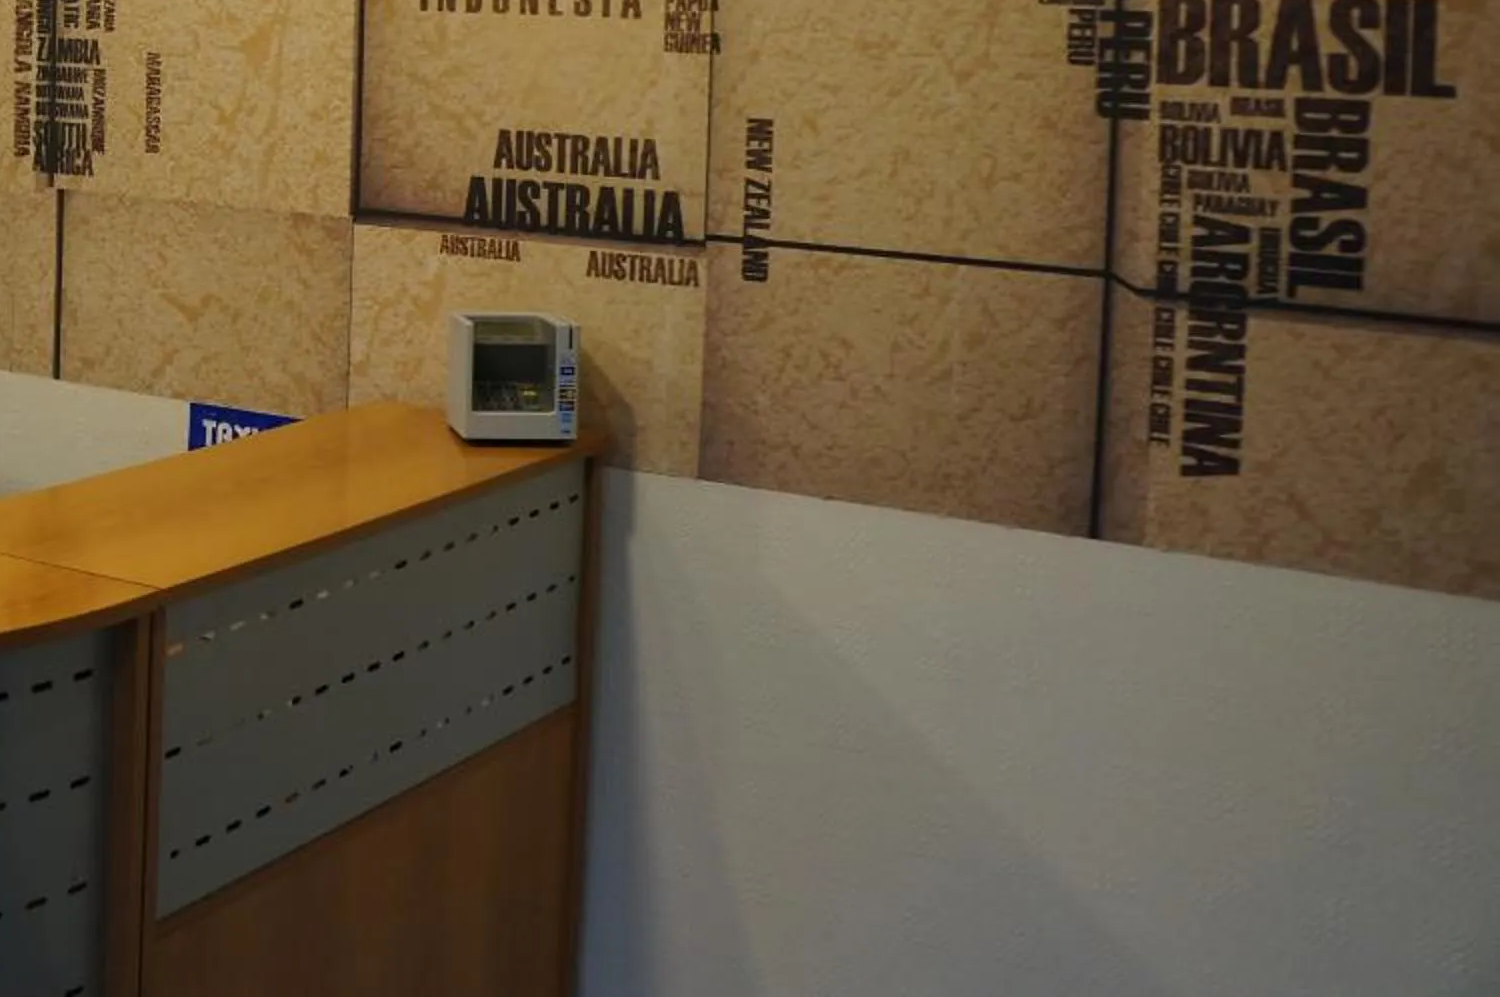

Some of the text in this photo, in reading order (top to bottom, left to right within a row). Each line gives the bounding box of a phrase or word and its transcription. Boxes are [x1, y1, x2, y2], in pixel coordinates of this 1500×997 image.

[662, 32, 722, 55] GUINEA
[663, 12, 703, 33] NEW
[1067, 7, 1097, 67] PERU
[1099, 9, 1151, 120] PERU
[492, 127, 662, 182] AUSTRALIA
[1157, 123, 1290, 173] BOLIVIA
[463, 173, 685, 243] AUSTRALIA
[740, 116, 776, 283] NEW ZEALAND
[1287, 97, 1374, 298] BRASIL
[439, 233, 522, 263] AUSTRALIA
[585, 249, 701, 287] AUSTRALIA
[1155, 260, 1180, 305] CHI
[201, 417, 260, 448] TAX
